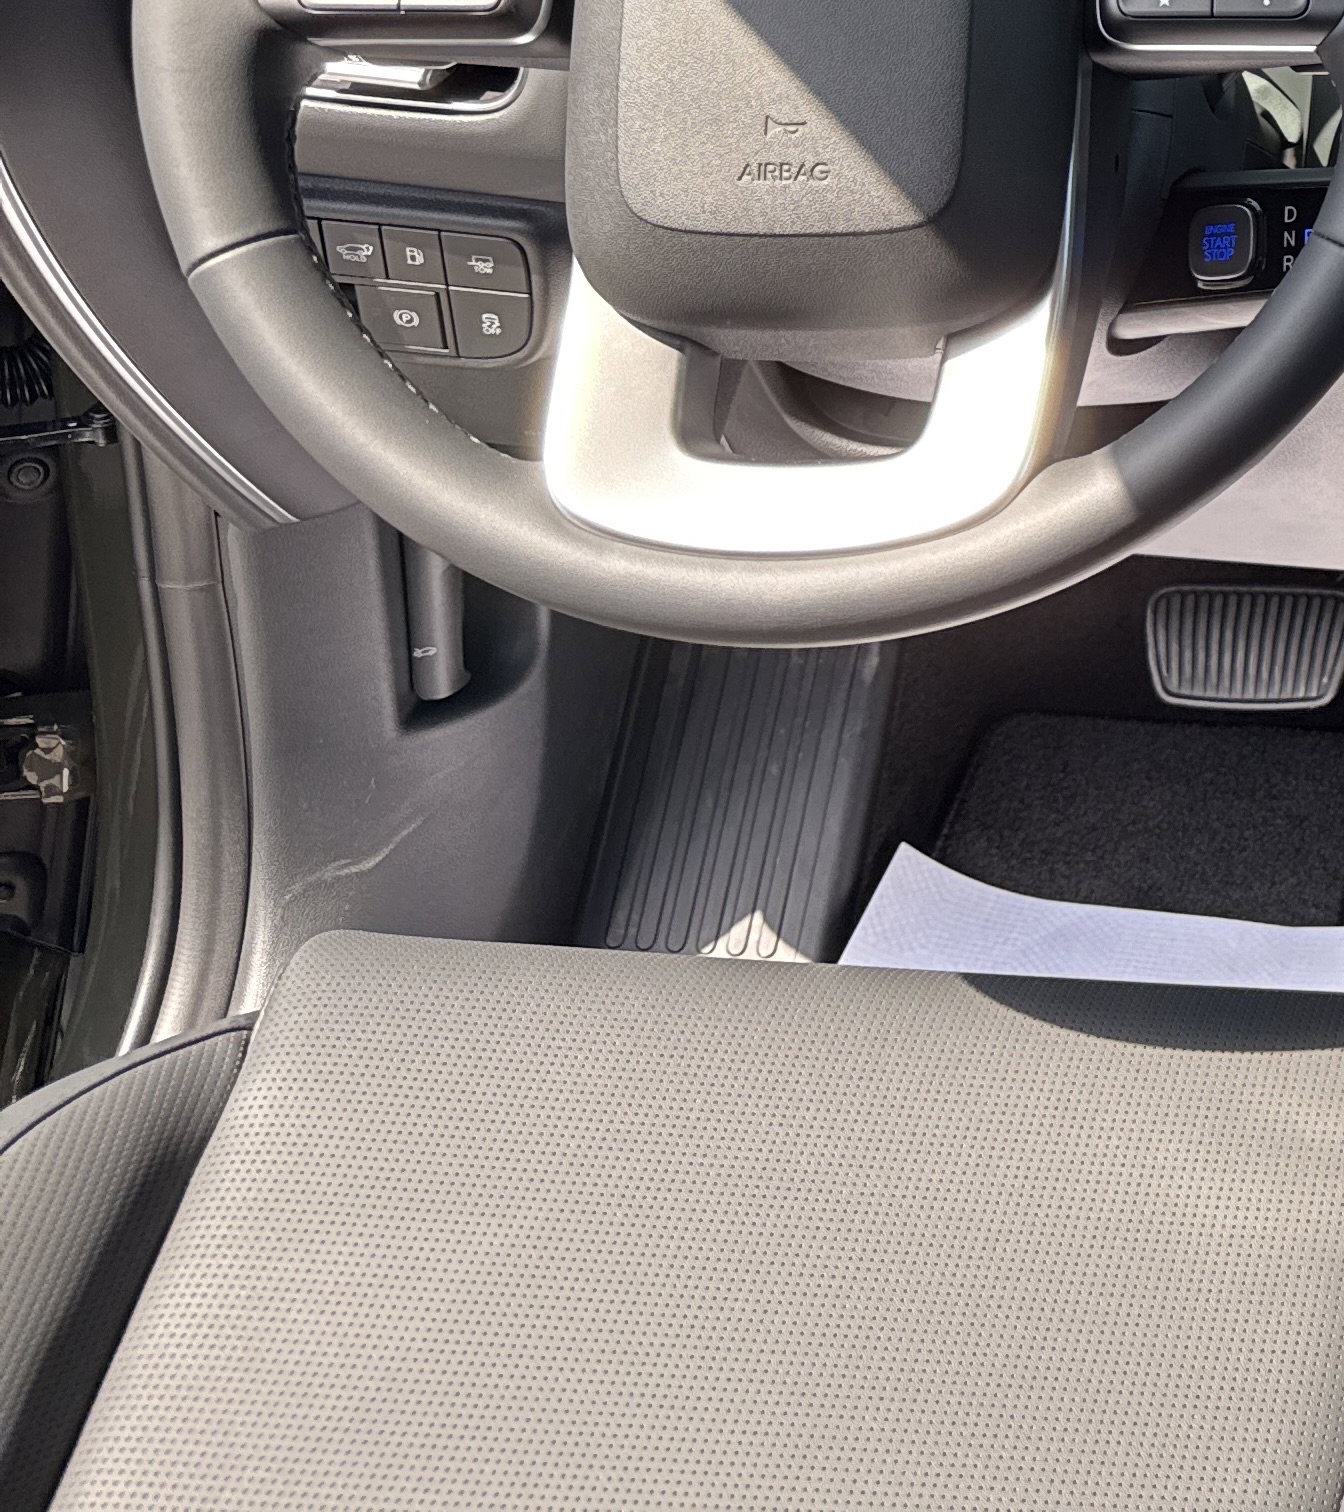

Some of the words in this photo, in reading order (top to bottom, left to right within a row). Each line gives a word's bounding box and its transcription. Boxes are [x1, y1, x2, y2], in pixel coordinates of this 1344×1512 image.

[736, 162, 831, 182] AIRBAG
[1284, 206, 1297, 223] D
[1202, 235, 1238, 249] START
[1283, 230, 1296, 247] N
[343, 254, 367, 263] HOLD
[1204, 249, 1234, 262] STOP
[474, 265, 494, 274] TOW
[1283, 255, 1294, 272] R
